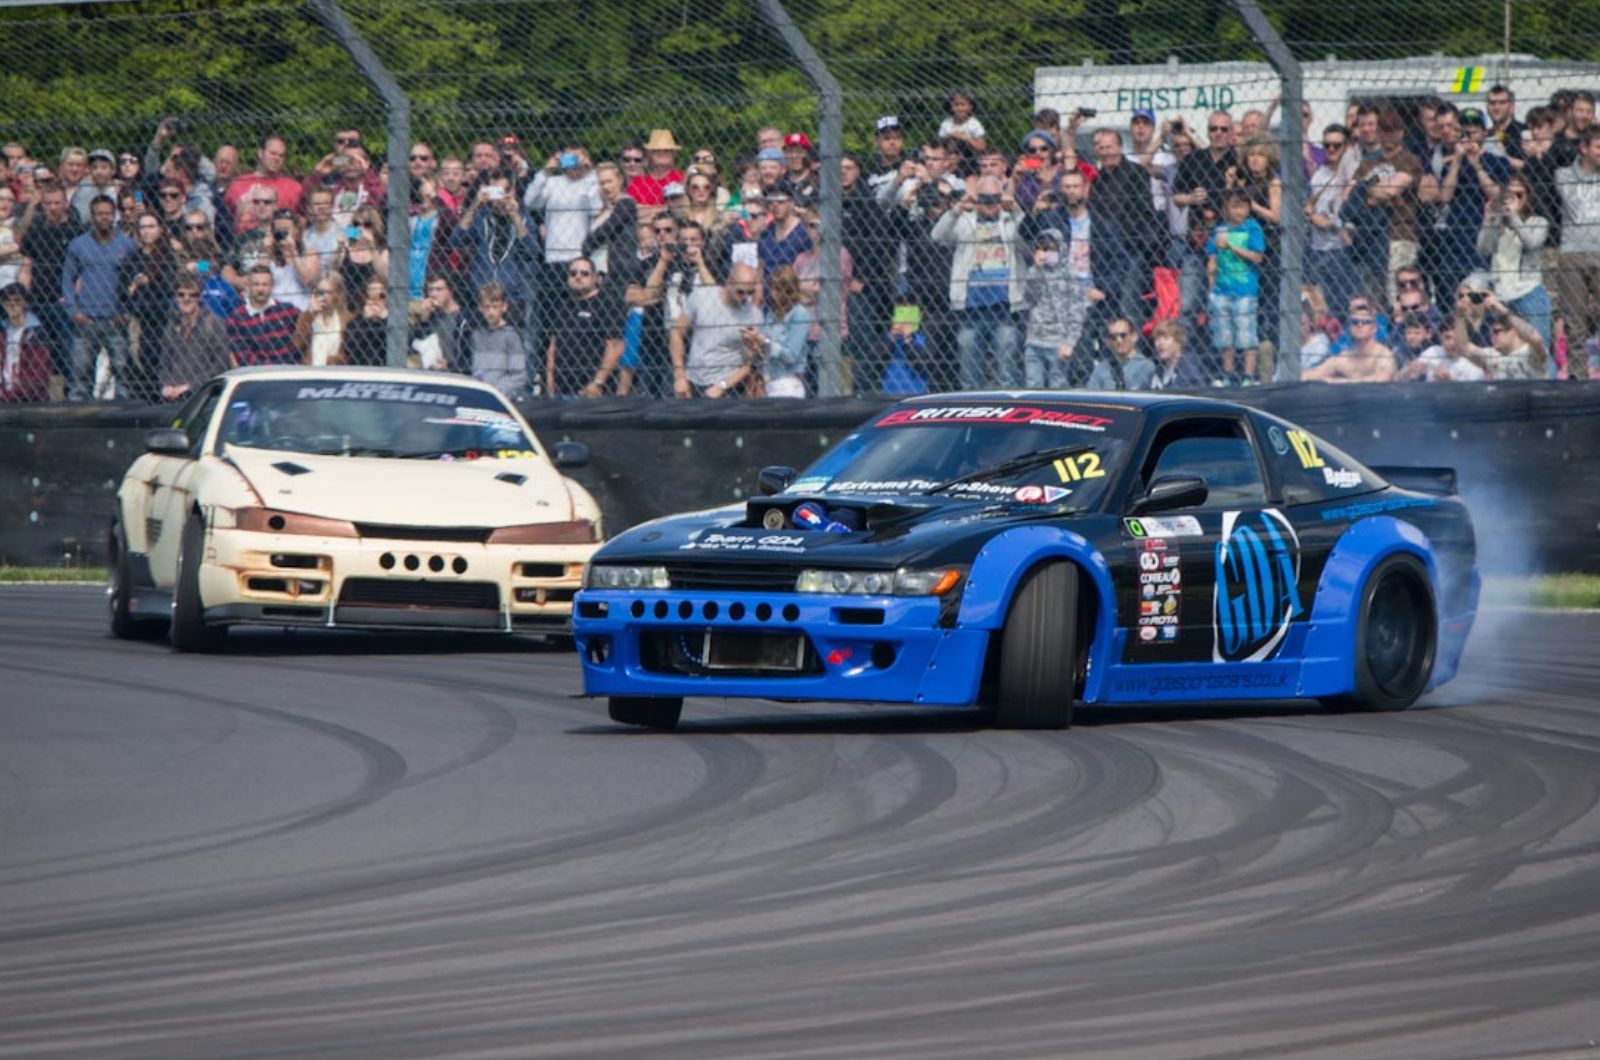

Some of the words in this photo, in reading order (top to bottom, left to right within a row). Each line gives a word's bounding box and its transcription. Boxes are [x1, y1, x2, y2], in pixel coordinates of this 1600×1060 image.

[1116, 87, 1187, 111] FIRST
[1195, 84, 1234, 111] AID
[1284, 428, 1326, 469] 112
[1052, 452, 1105, 483] 112
[1215, 510, 1304, 655] GDA
